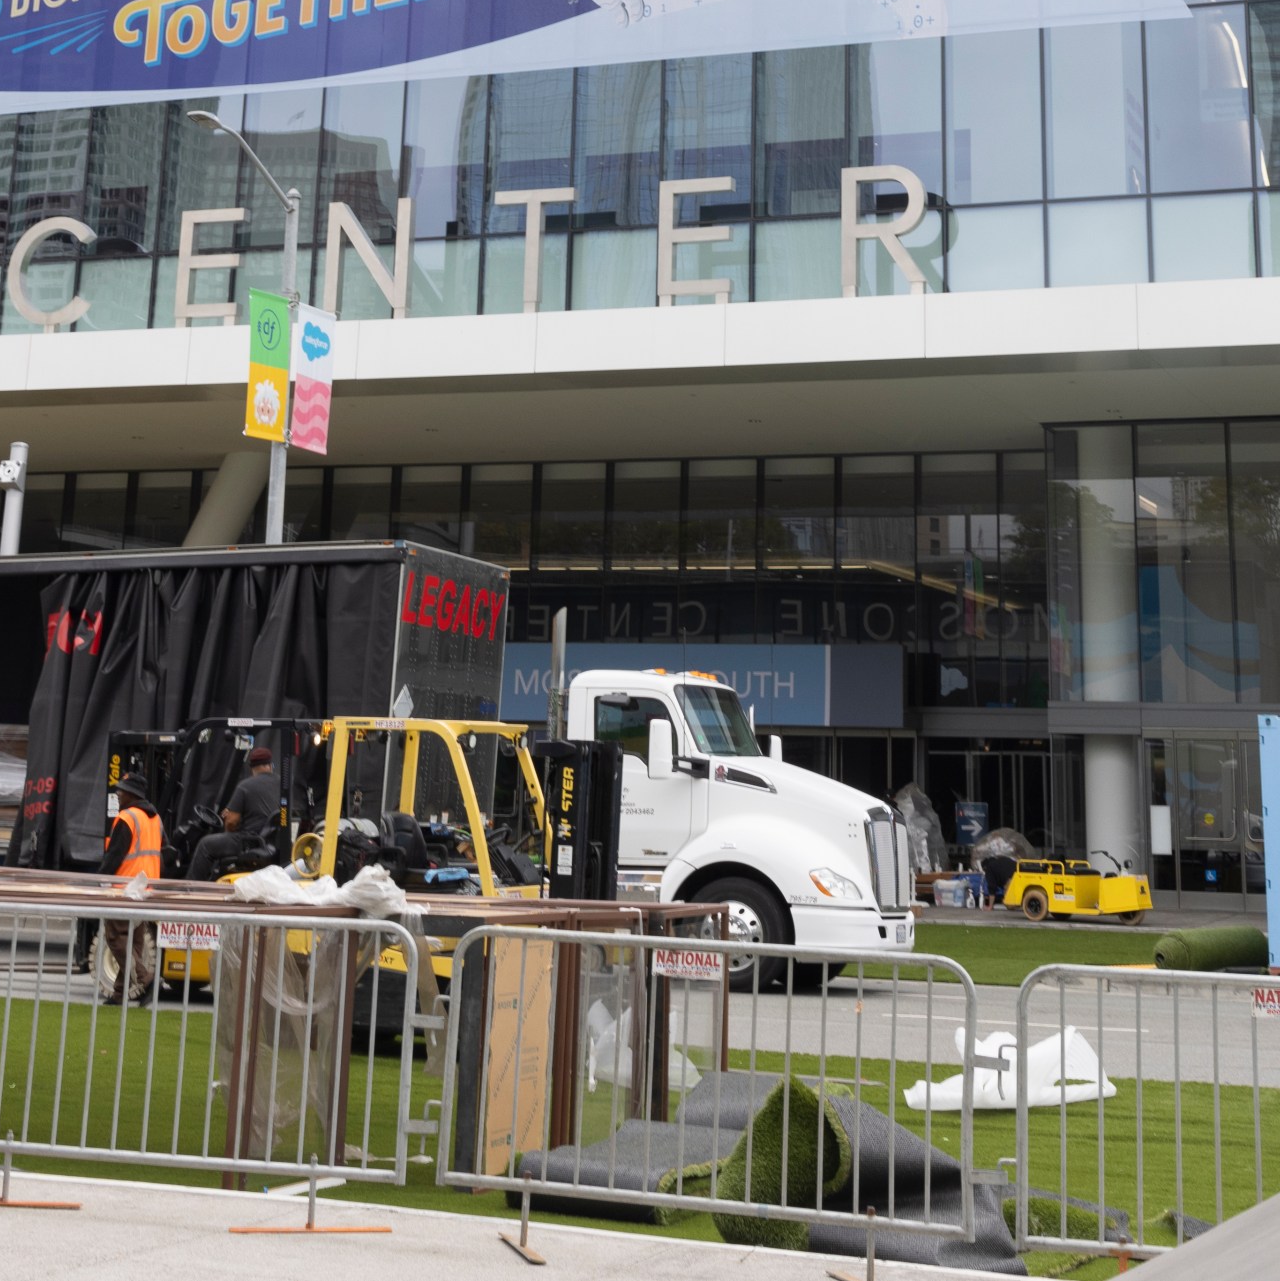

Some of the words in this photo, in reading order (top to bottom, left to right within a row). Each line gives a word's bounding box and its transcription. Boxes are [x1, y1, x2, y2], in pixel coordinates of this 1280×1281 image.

[7, 165, 929, 333] CENTER
[401, 571, 506, 641] LEGACY
[108, 754, 121, 787] Yale
[160, 922, 218, 937] NATIONAL
[656, 950, 720, 967] NATIONAL
